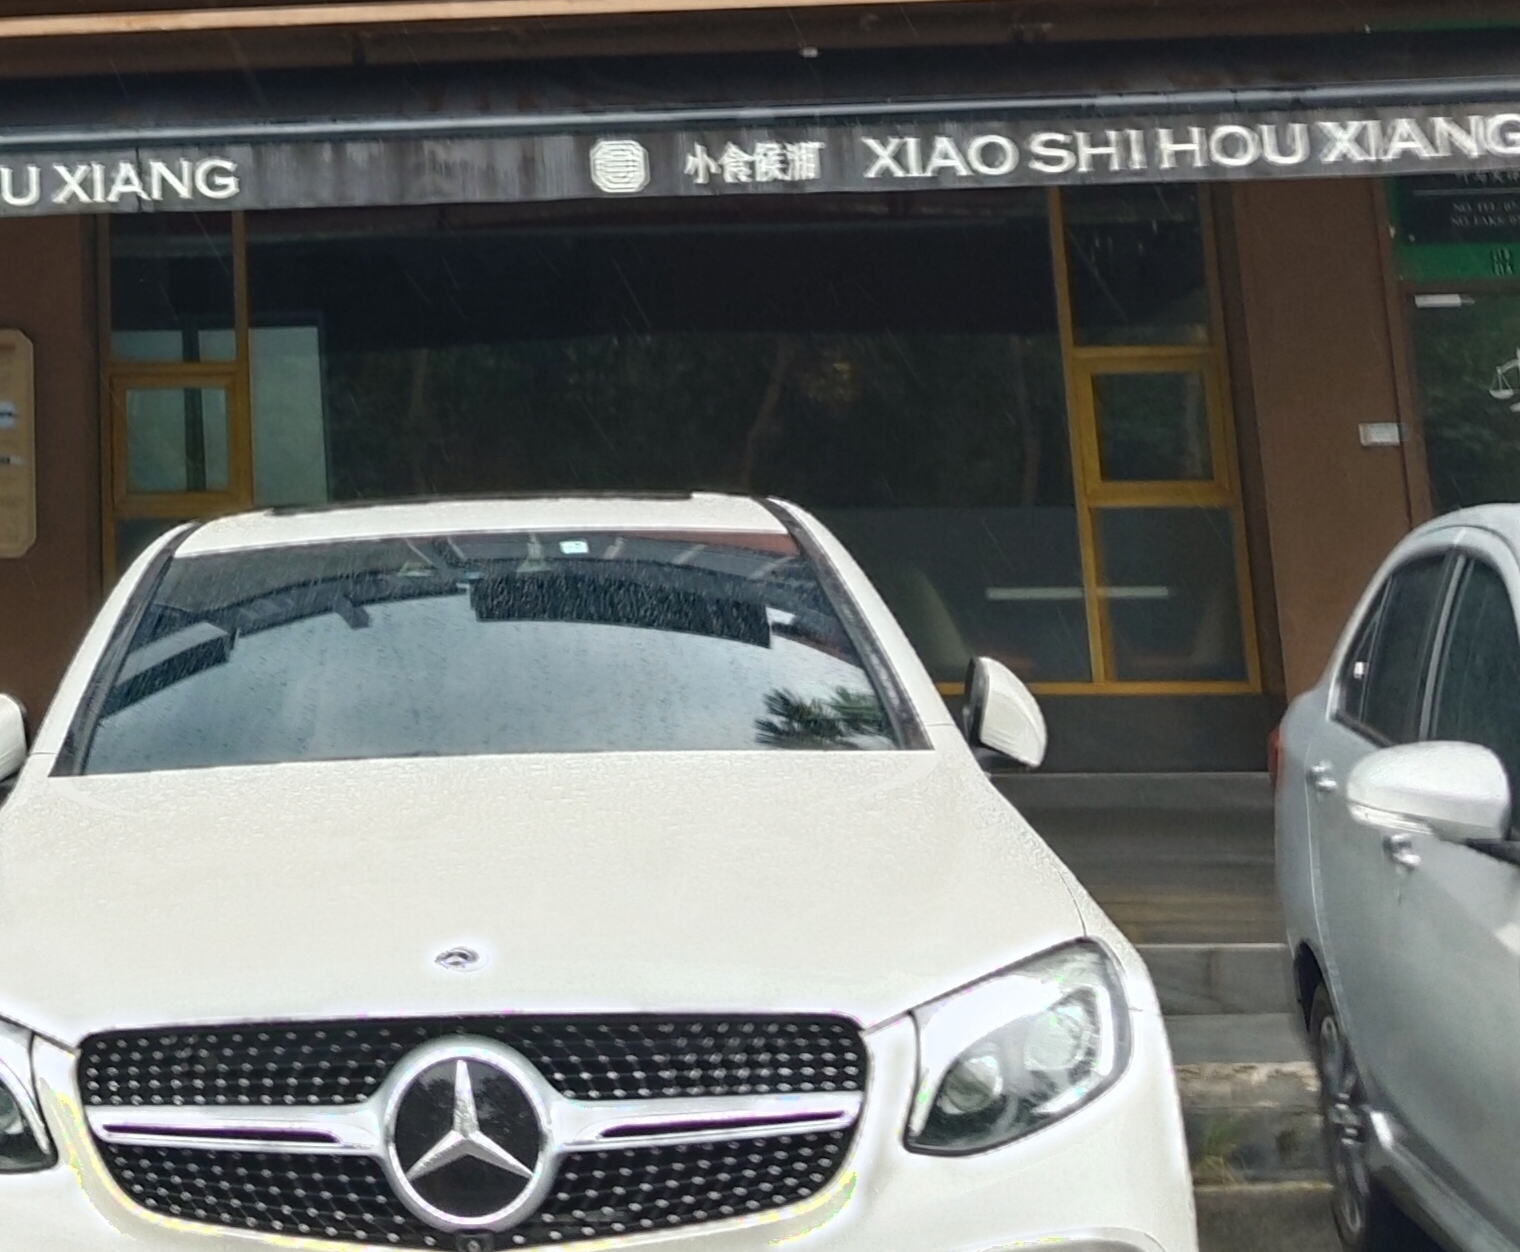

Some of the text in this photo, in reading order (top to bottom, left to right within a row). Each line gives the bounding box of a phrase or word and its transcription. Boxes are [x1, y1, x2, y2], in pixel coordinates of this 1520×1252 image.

[862, 112, 1520, 179] XIAO SHI HOU XIANG
[51, 156, 241, 205] XIANG
